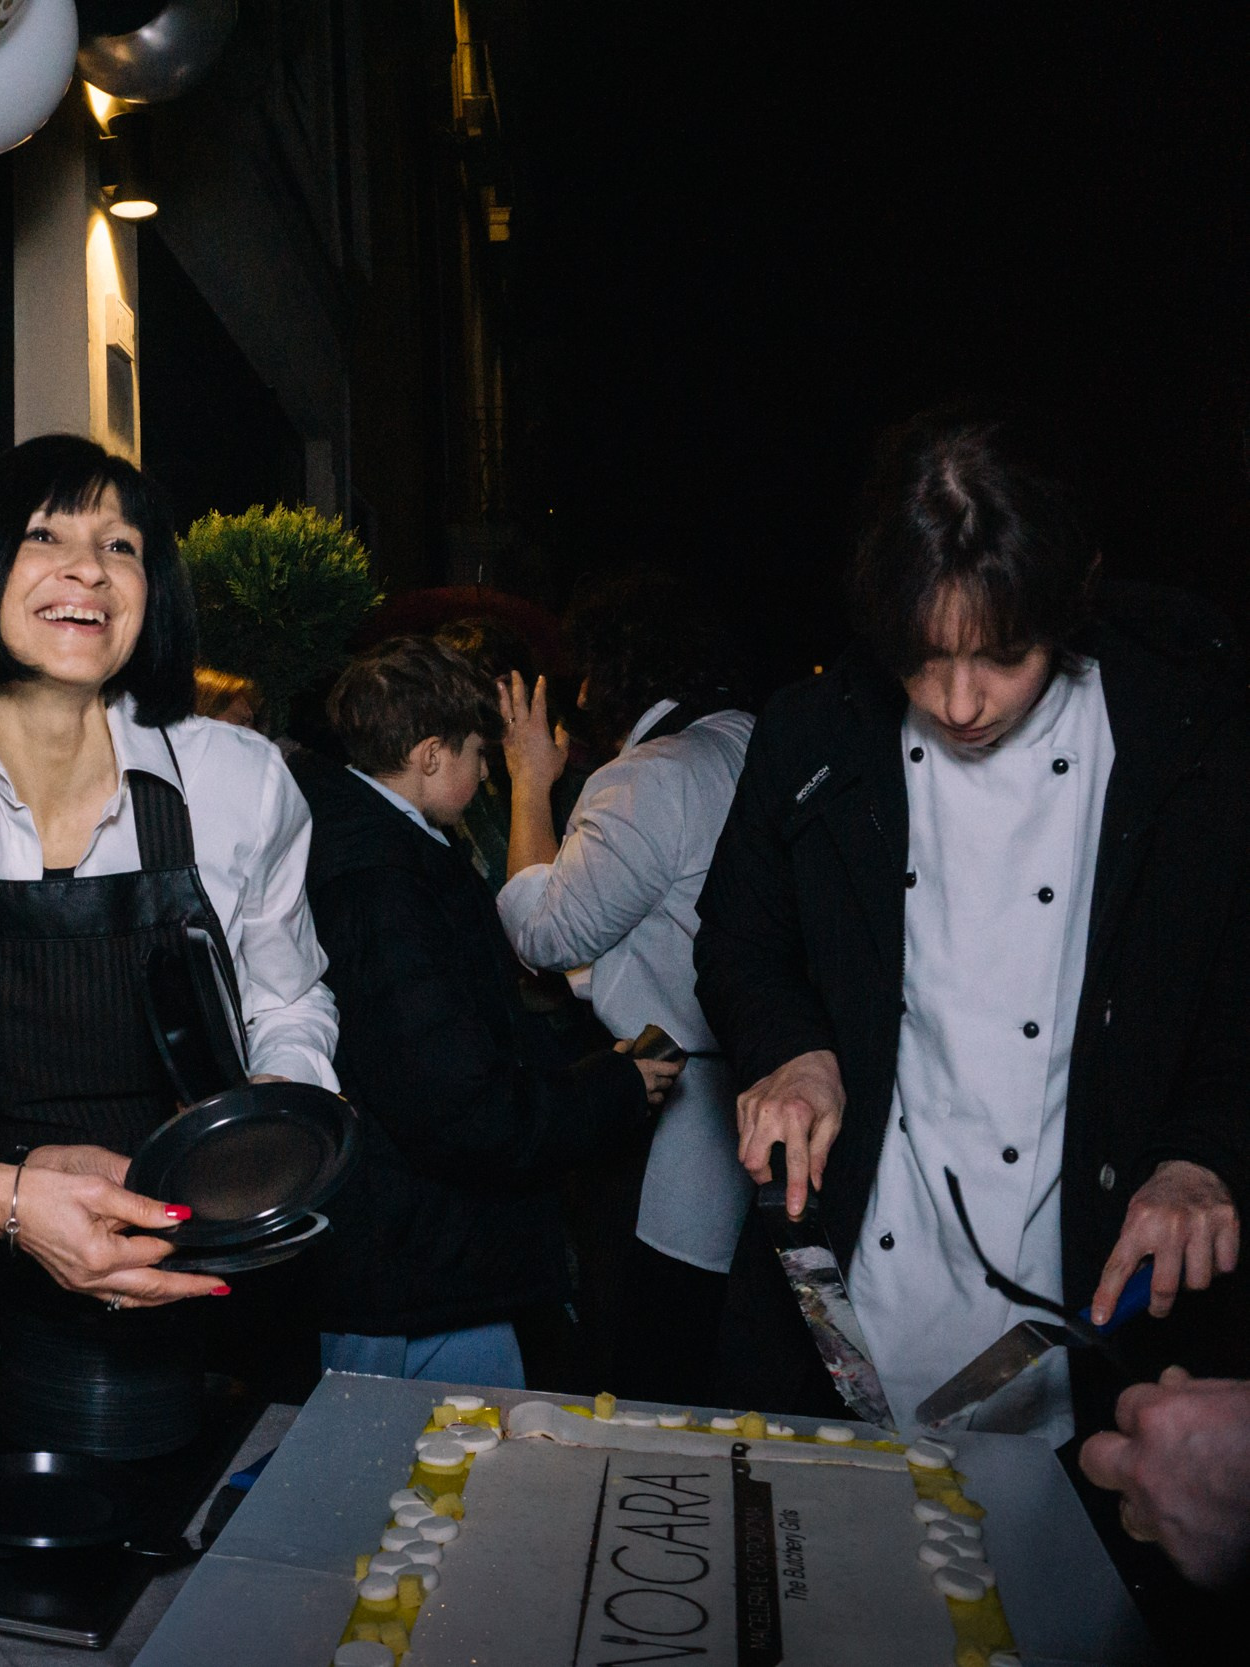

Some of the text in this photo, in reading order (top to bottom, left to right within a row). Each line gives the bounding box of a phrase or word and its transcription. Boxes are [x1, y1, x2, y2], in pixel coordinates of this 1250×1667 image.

[778, 1509, 808, 1601] The Butchery Girls
